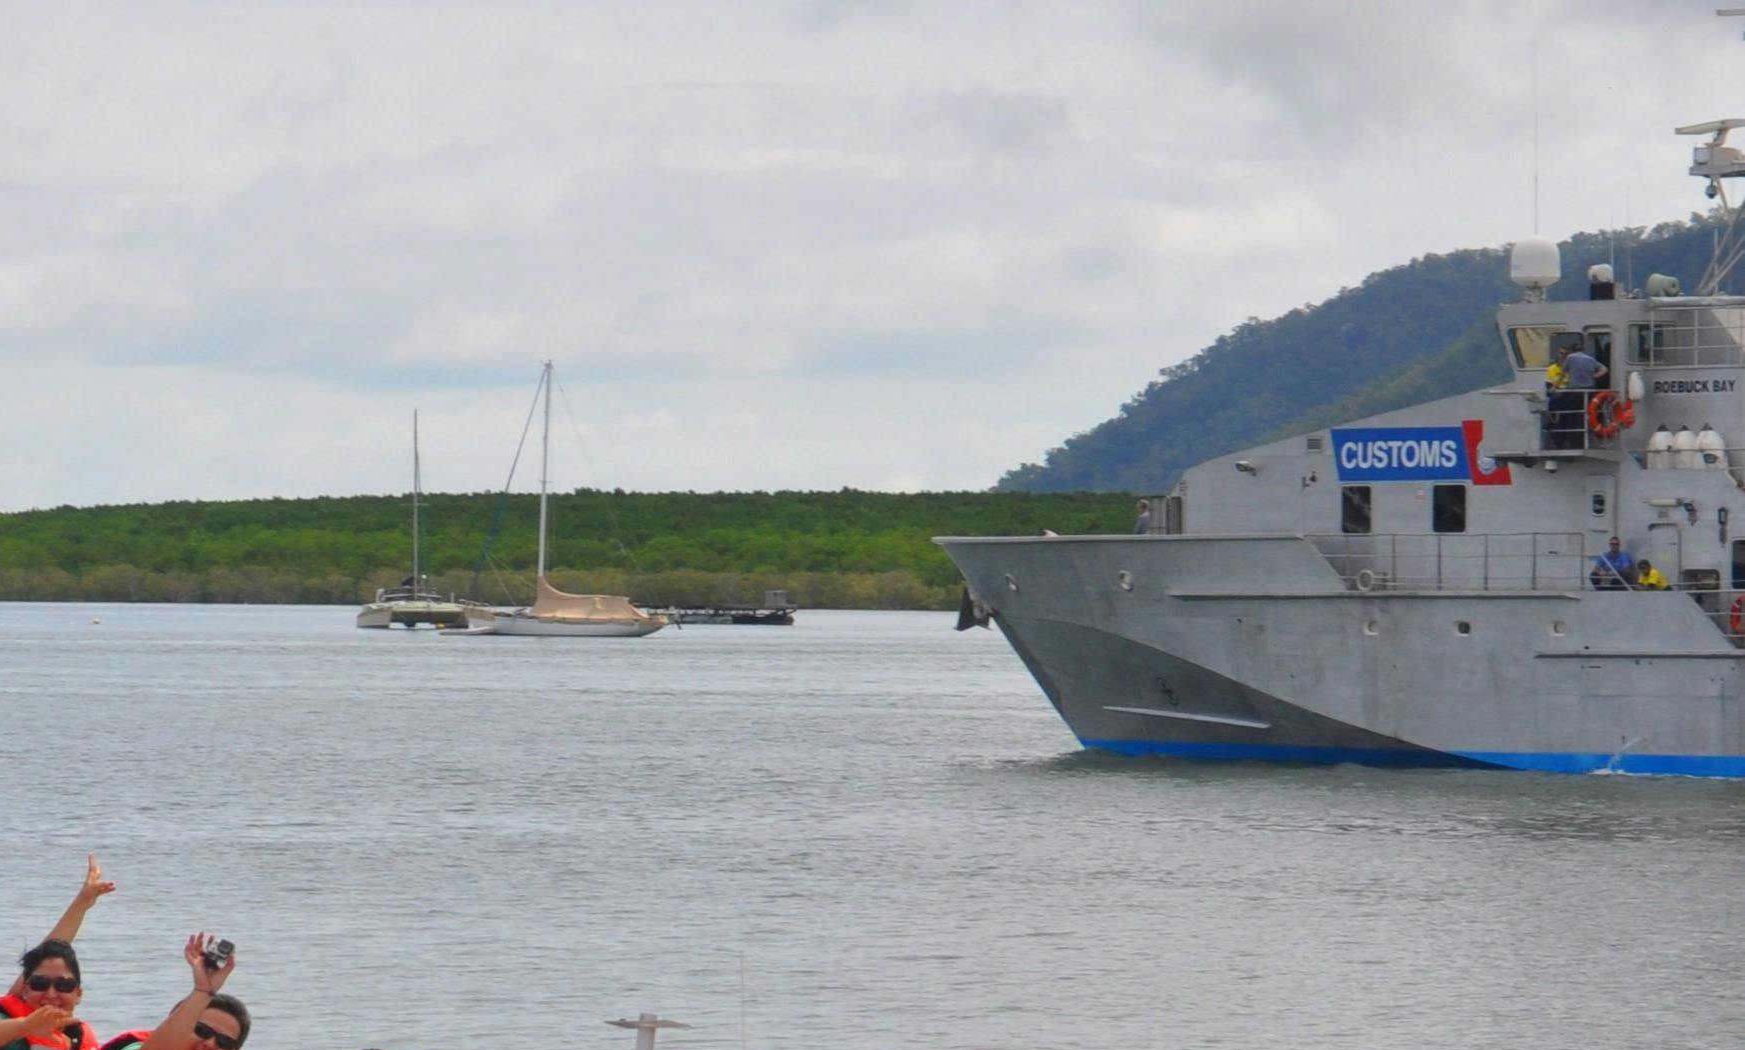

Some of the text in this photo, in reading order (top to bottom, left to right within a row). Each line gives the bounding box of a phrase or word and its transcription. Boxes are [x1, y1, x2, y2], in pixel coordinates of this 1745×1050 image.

[1654, 380, 1736, 394] ROEBUCK BAY
[1340, 440, 1458, 469] CUSTOMS
